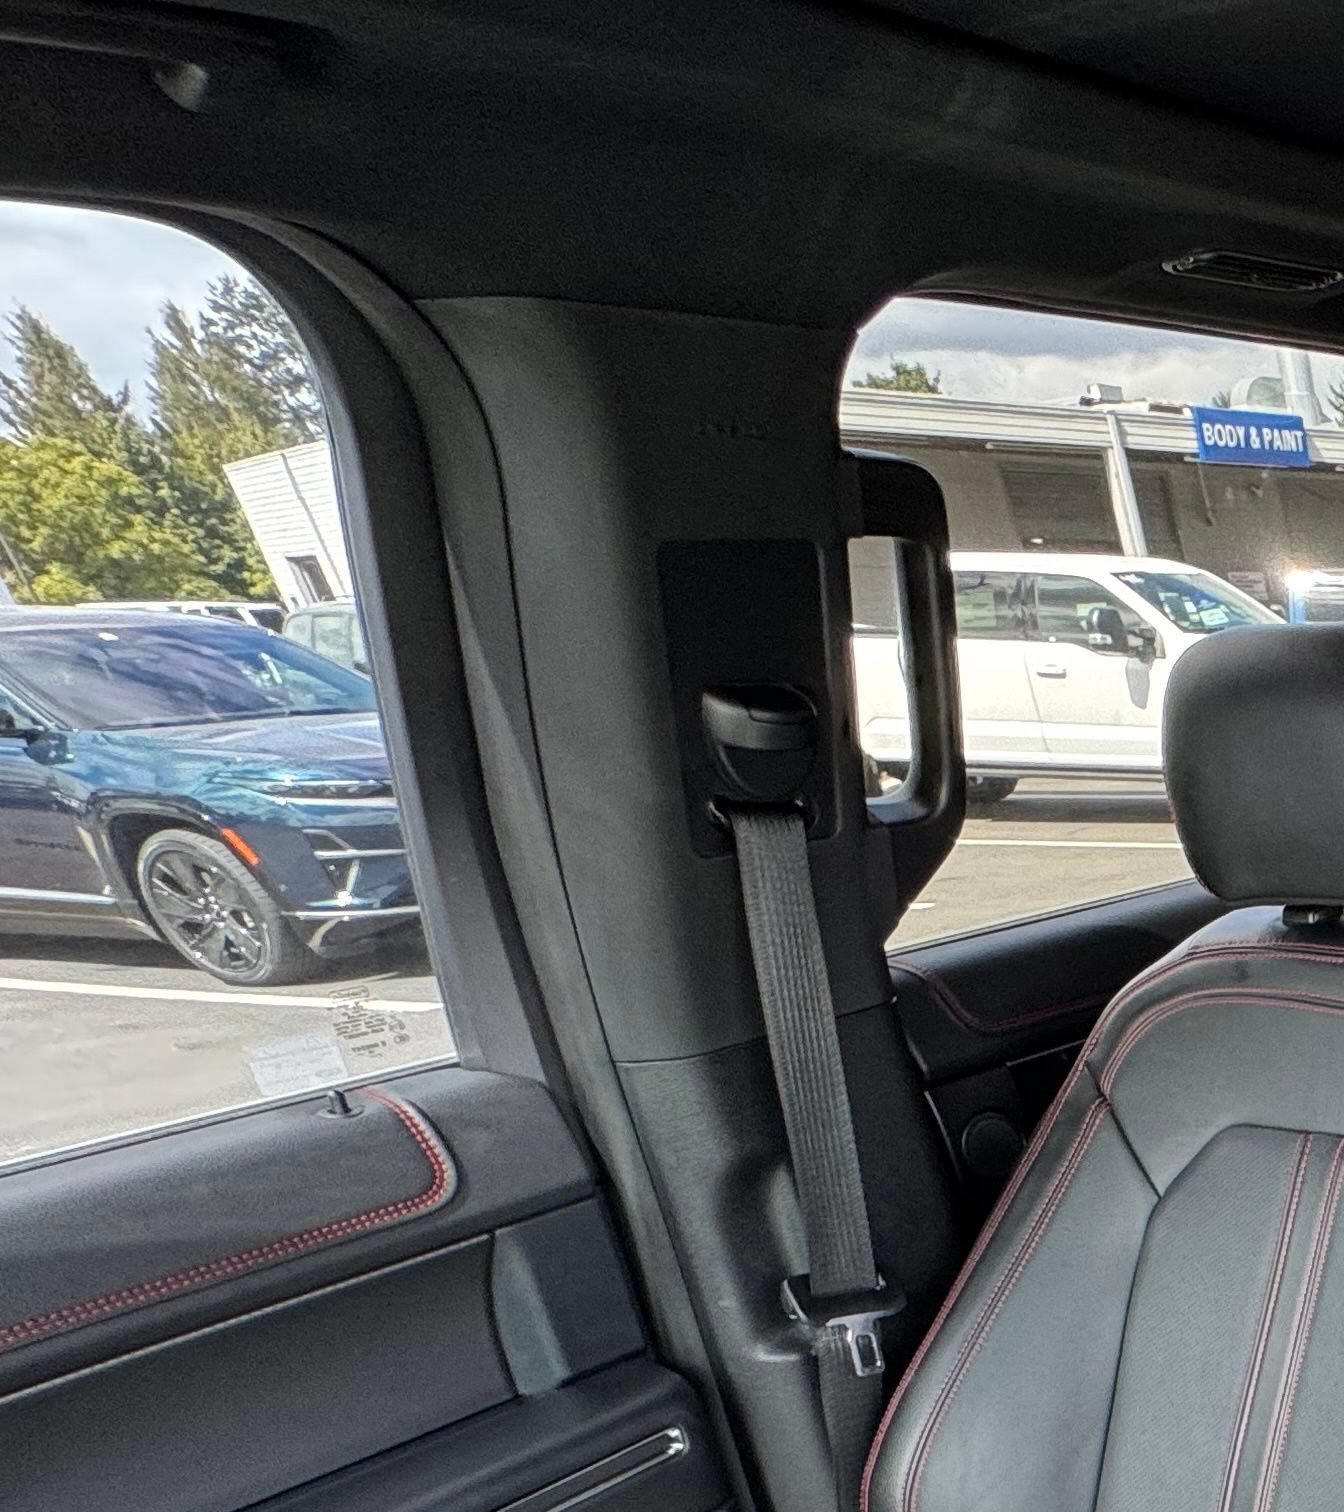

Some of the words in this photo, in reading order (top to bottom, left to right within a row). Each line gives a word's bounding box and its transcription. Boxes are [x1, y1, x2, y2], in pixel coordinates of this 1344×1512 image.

[1202, 423, 1245, 448] BODY
[1249, 426, 1261, 449] &
[1262, 427, 1304, 452] PAINT
